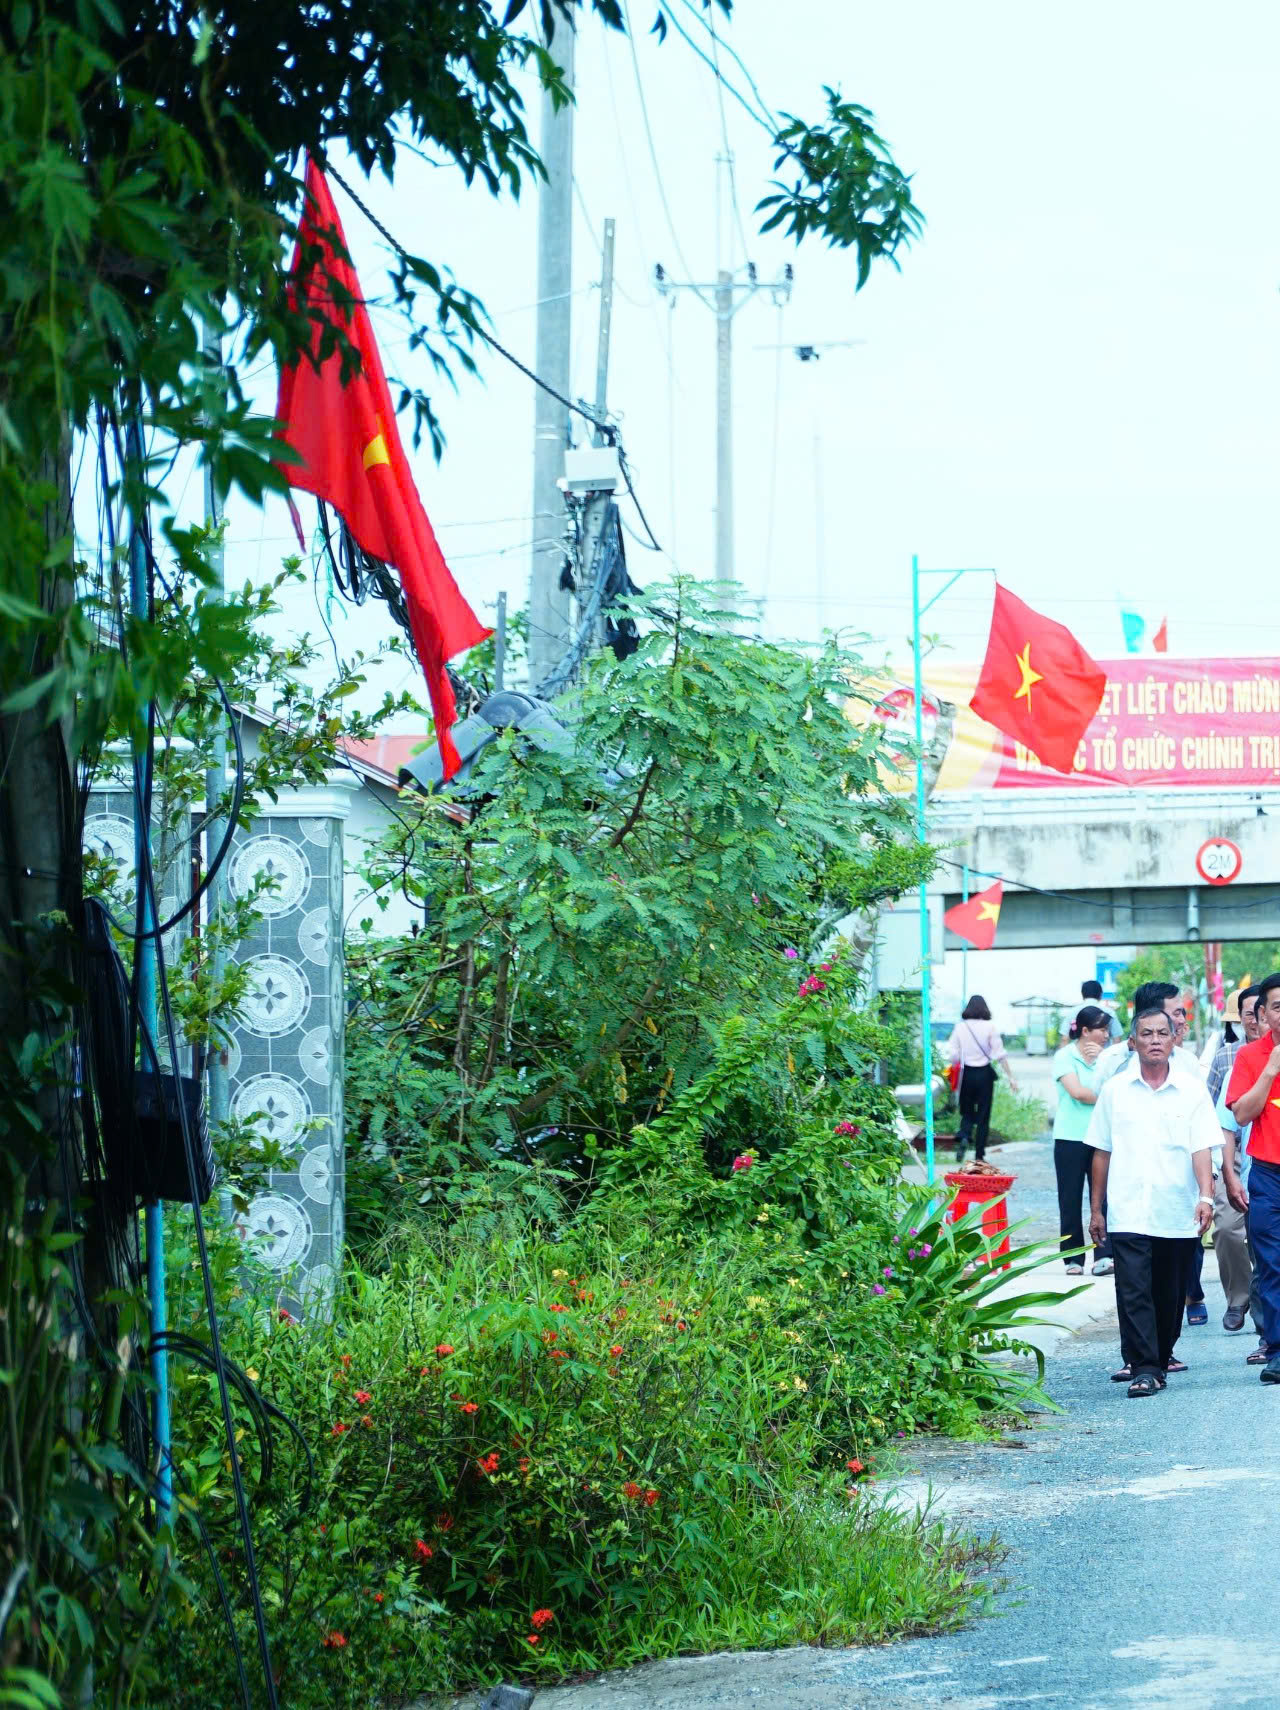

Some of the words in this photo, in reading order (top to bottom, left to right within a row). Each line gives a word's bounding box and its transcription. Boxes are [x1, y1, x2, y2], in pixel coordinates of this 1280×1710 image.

[1127, 675, 1168, 721] LIỆT
[1173, 675, 1227, 715] CHÀO
[1091, 725, 1117, 771] TỔ
[1122, 729, 1176, 771] CHỨC
[1181, 729, 1243, 770] CHÍNH
[1248, 735, 1280, 776] TRỊ
